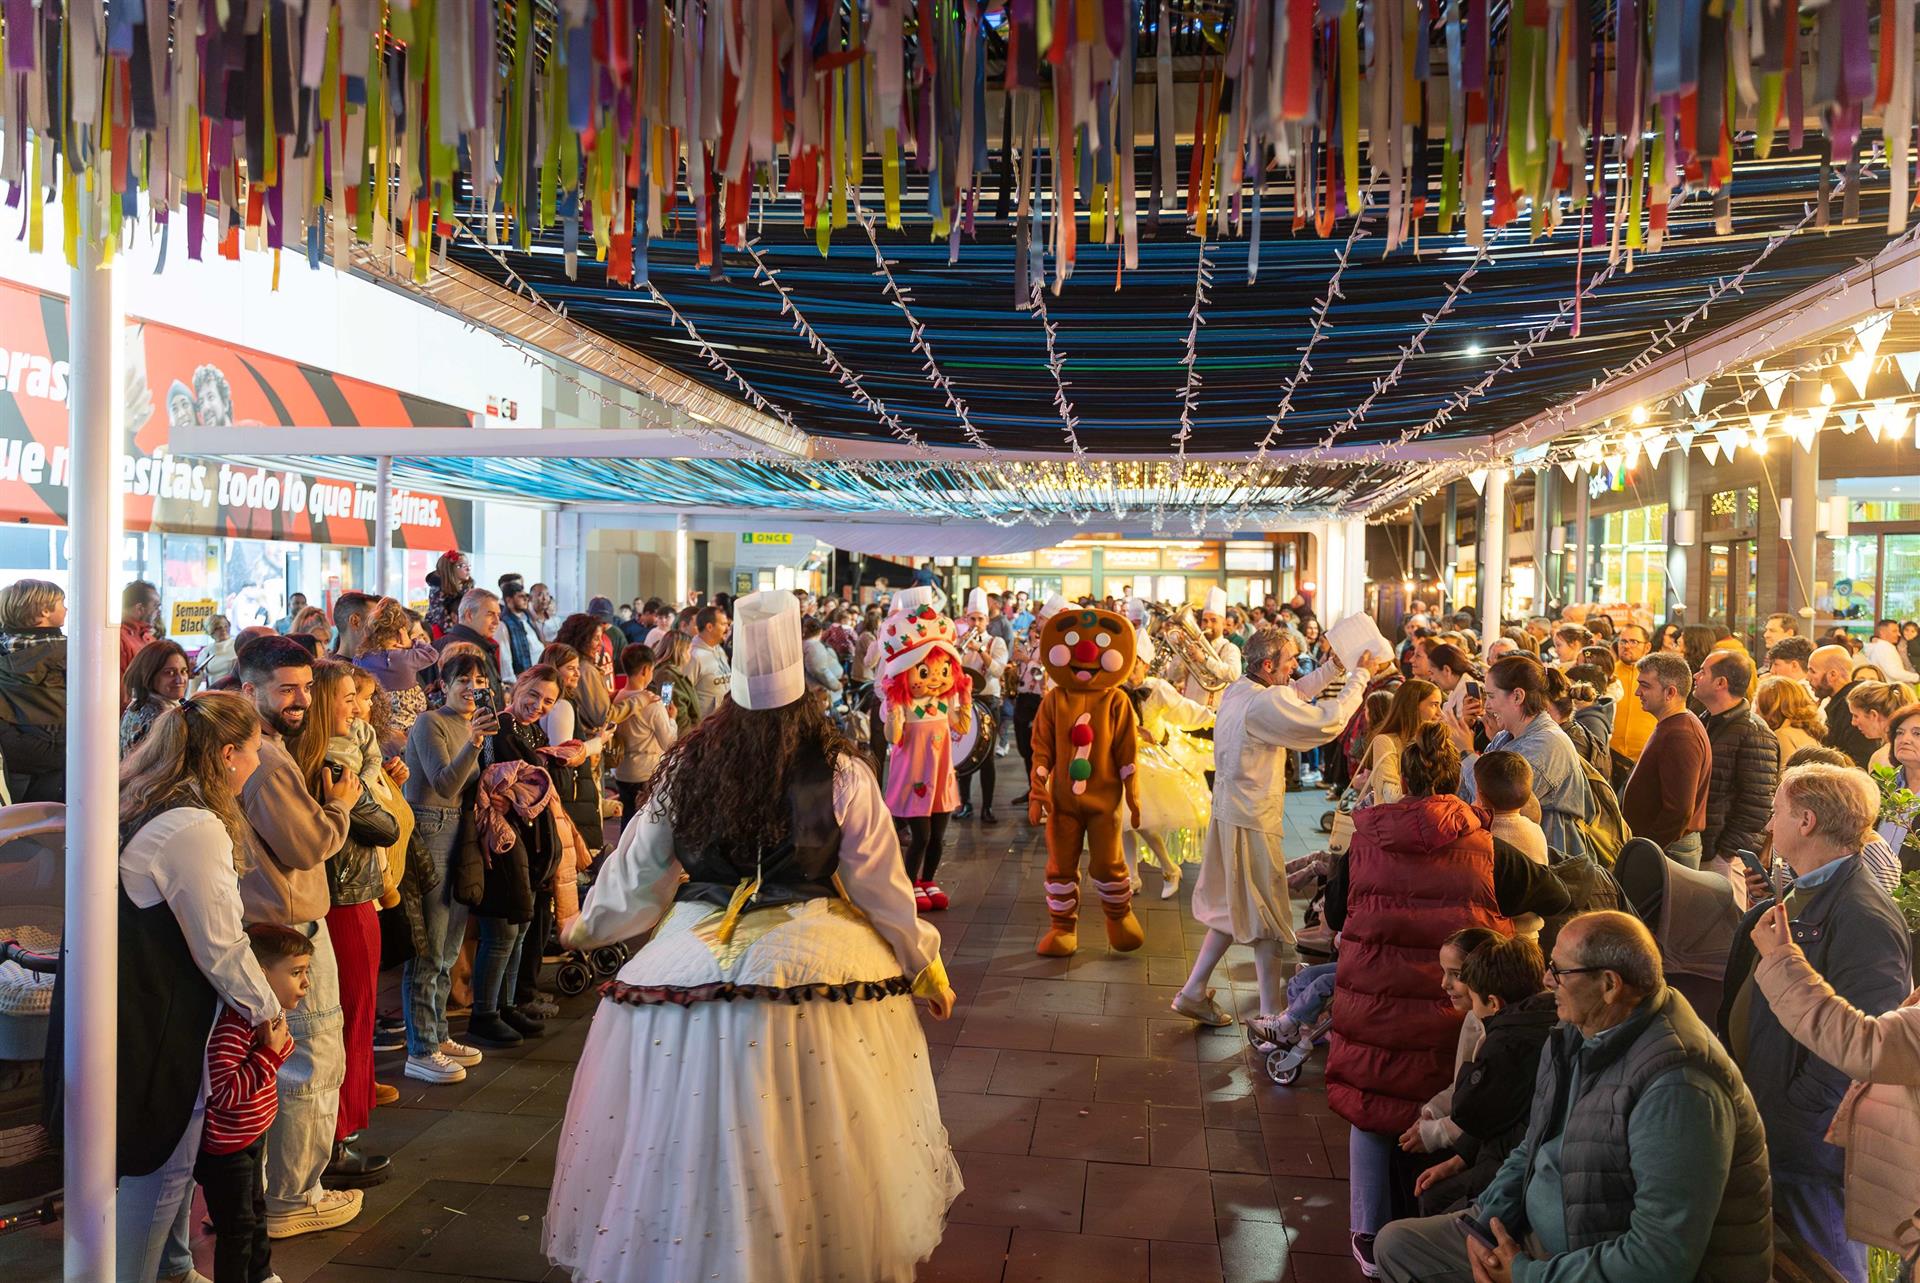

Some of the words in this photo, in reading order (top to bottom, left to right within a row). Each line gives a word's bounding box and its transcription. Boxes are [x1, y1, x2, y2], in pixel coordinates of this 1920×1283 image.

[218, 463, 280, 511] todo
[282, 472, 307, 513] lo
[309, 483, 352, 523] que
[352, 482, 442, 531] imginas.
[757, 534, 788, 543] ONCE
